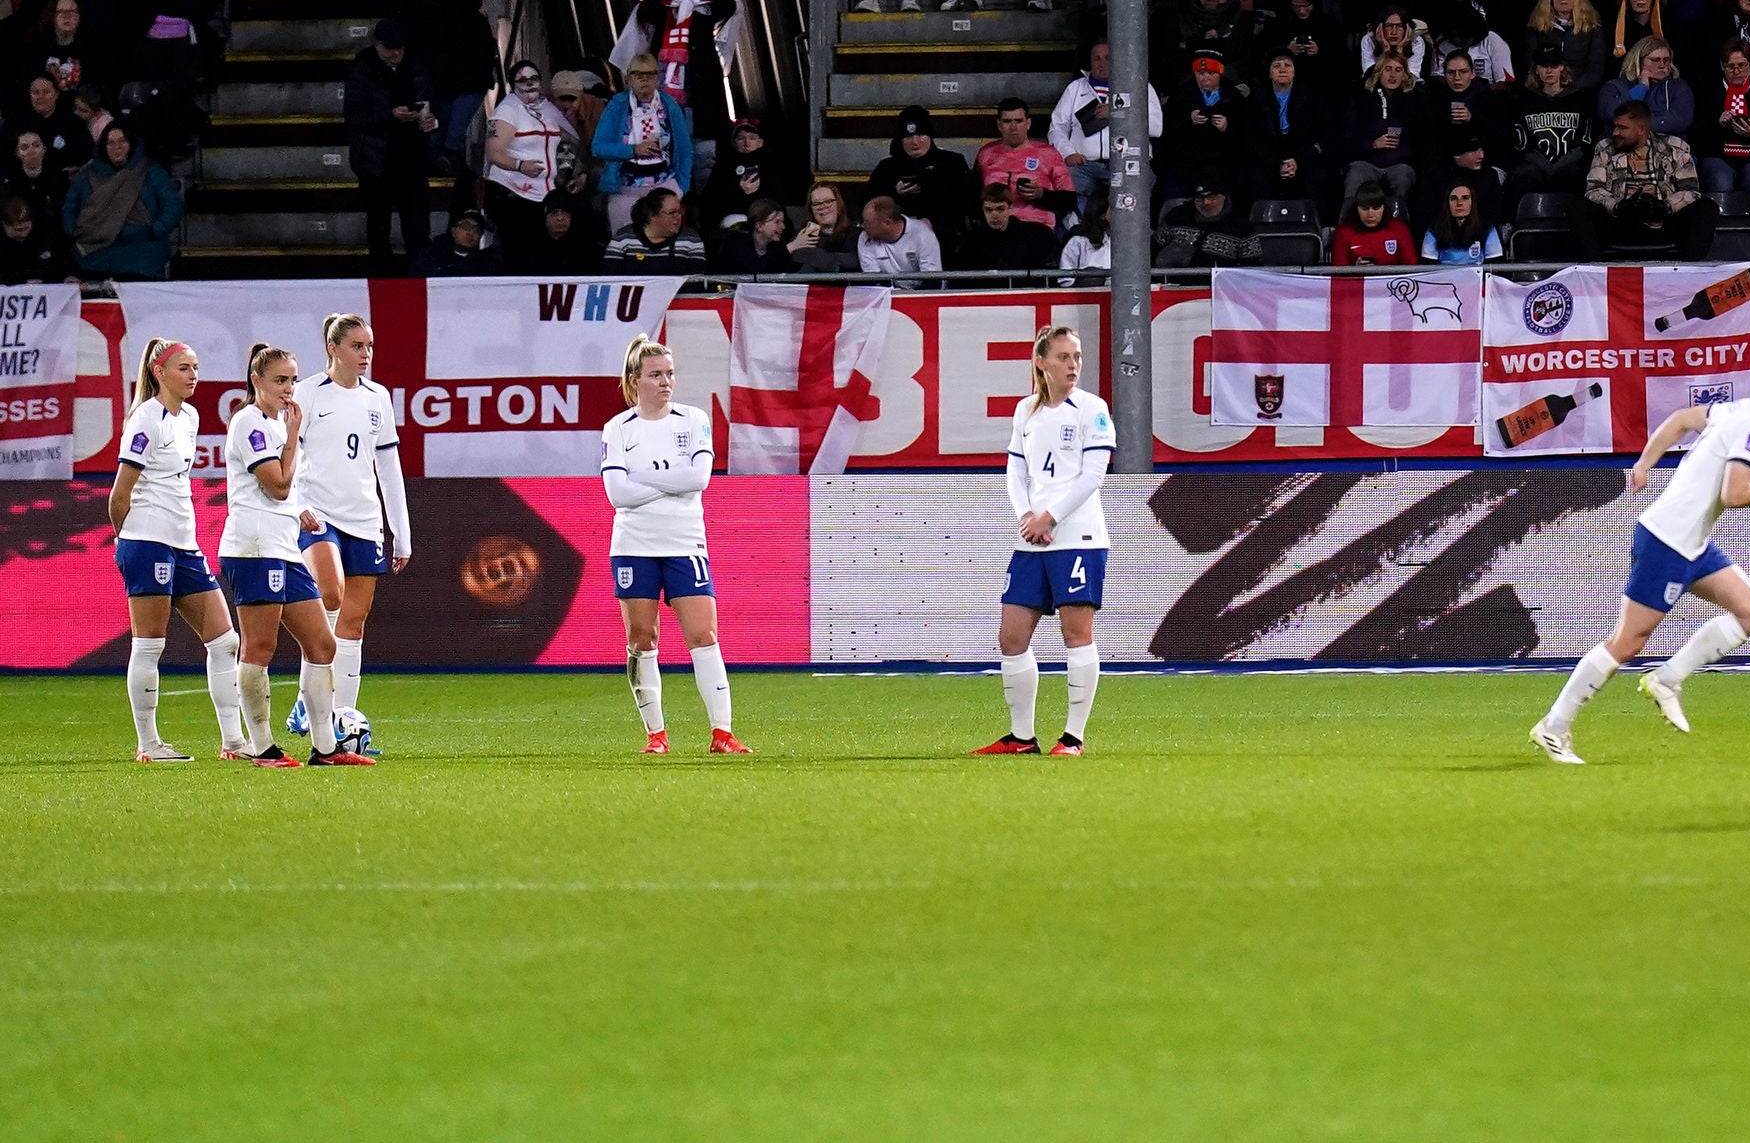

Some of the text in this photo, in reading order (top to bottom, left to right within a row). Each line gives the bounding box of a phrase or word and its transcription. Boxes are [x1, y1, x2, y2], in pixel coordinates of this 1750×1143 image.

[1524, 112, 1580, 130] BROOKLYN
[538, 284, 645, 322] WHU
[1501, 342, 1749, 374] WORCESTER CITY
[347, 433, 359, 460] 9
[1042, 452, 1055, 478] 4
[689, 556, 710, 581] 11
[1071, 556, 1087, 584] 4
